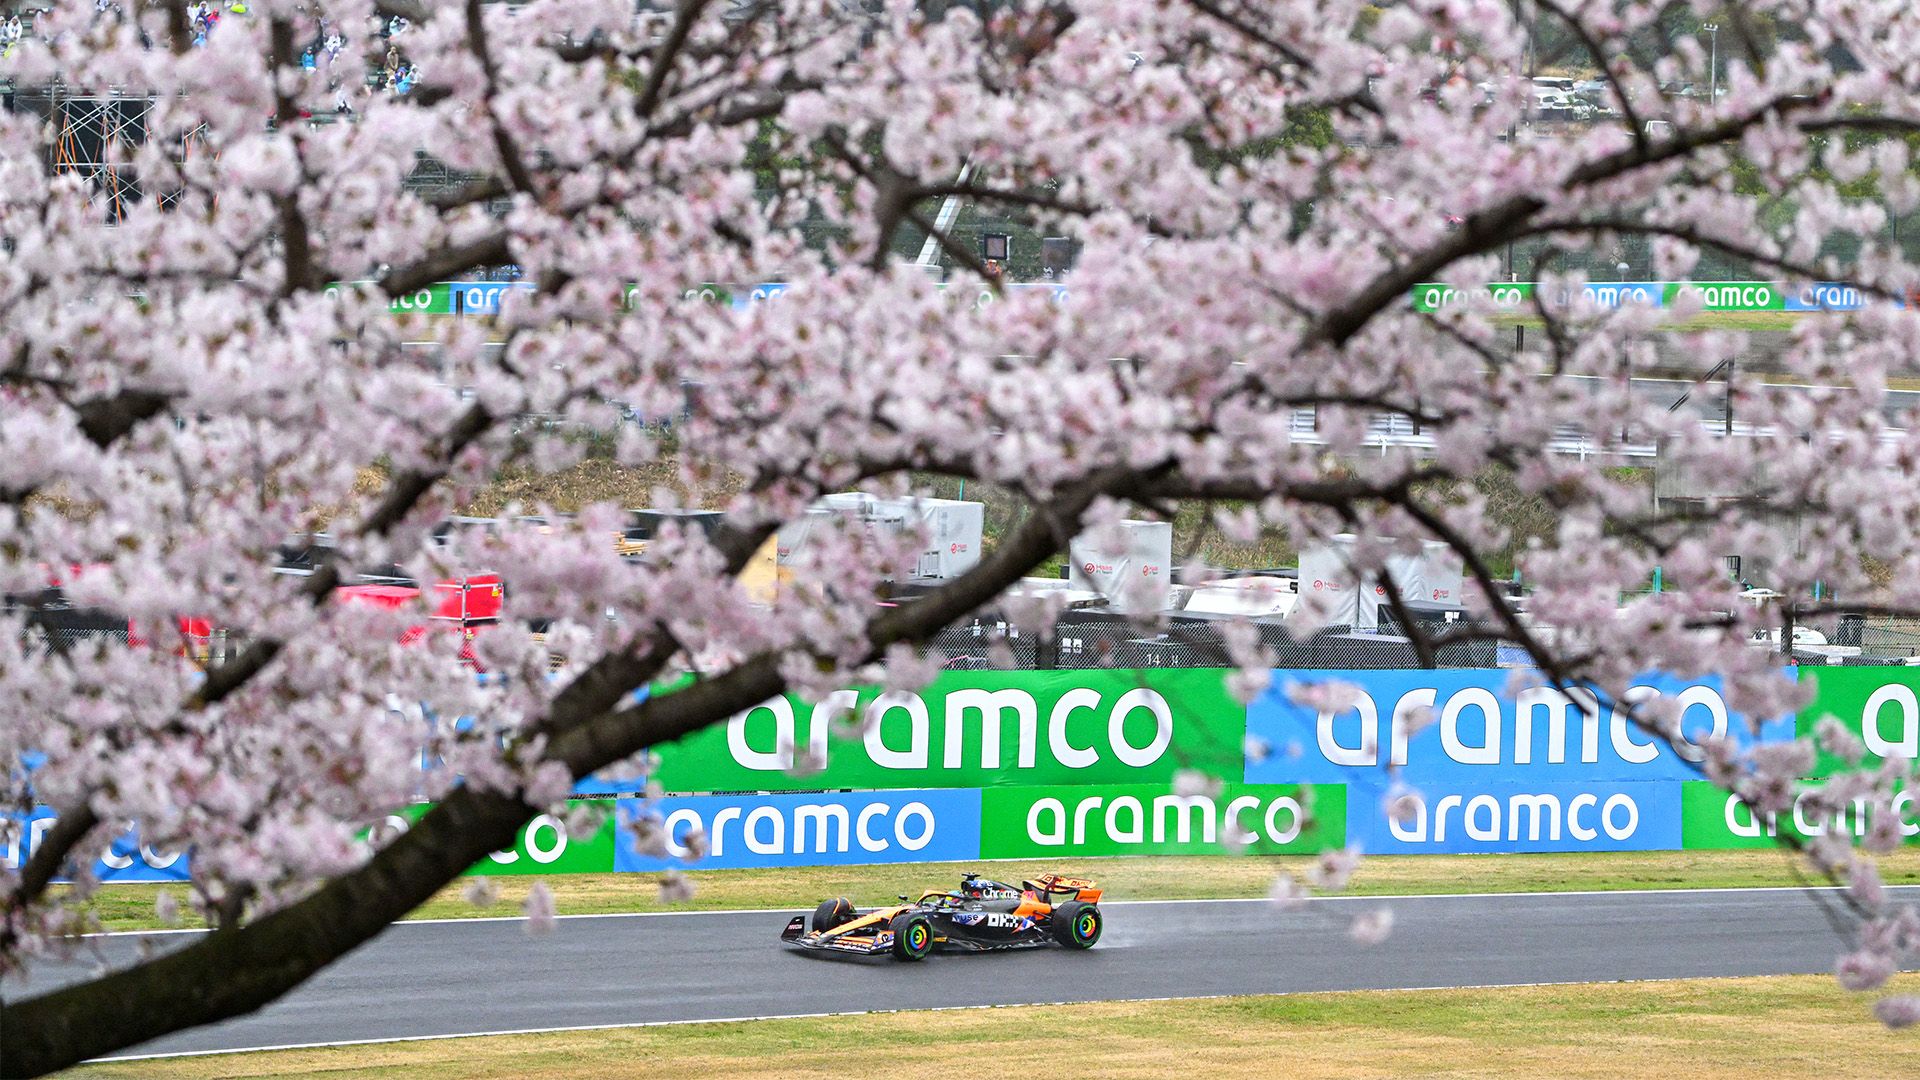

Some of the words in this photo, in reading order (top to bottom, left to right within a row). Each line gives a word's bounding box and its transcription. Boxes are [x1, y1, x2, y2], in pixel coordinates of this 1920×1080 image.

[727, 687, 1173, 770] aramco
[1316, 685, 1728, 766] aramco
[664, 801, 935, 857] aramco
[1026, 795, 1303, 845] aramco
[1388, 793, 1639, 843] aramco
[983, 887, 1018, 899] Chrome
